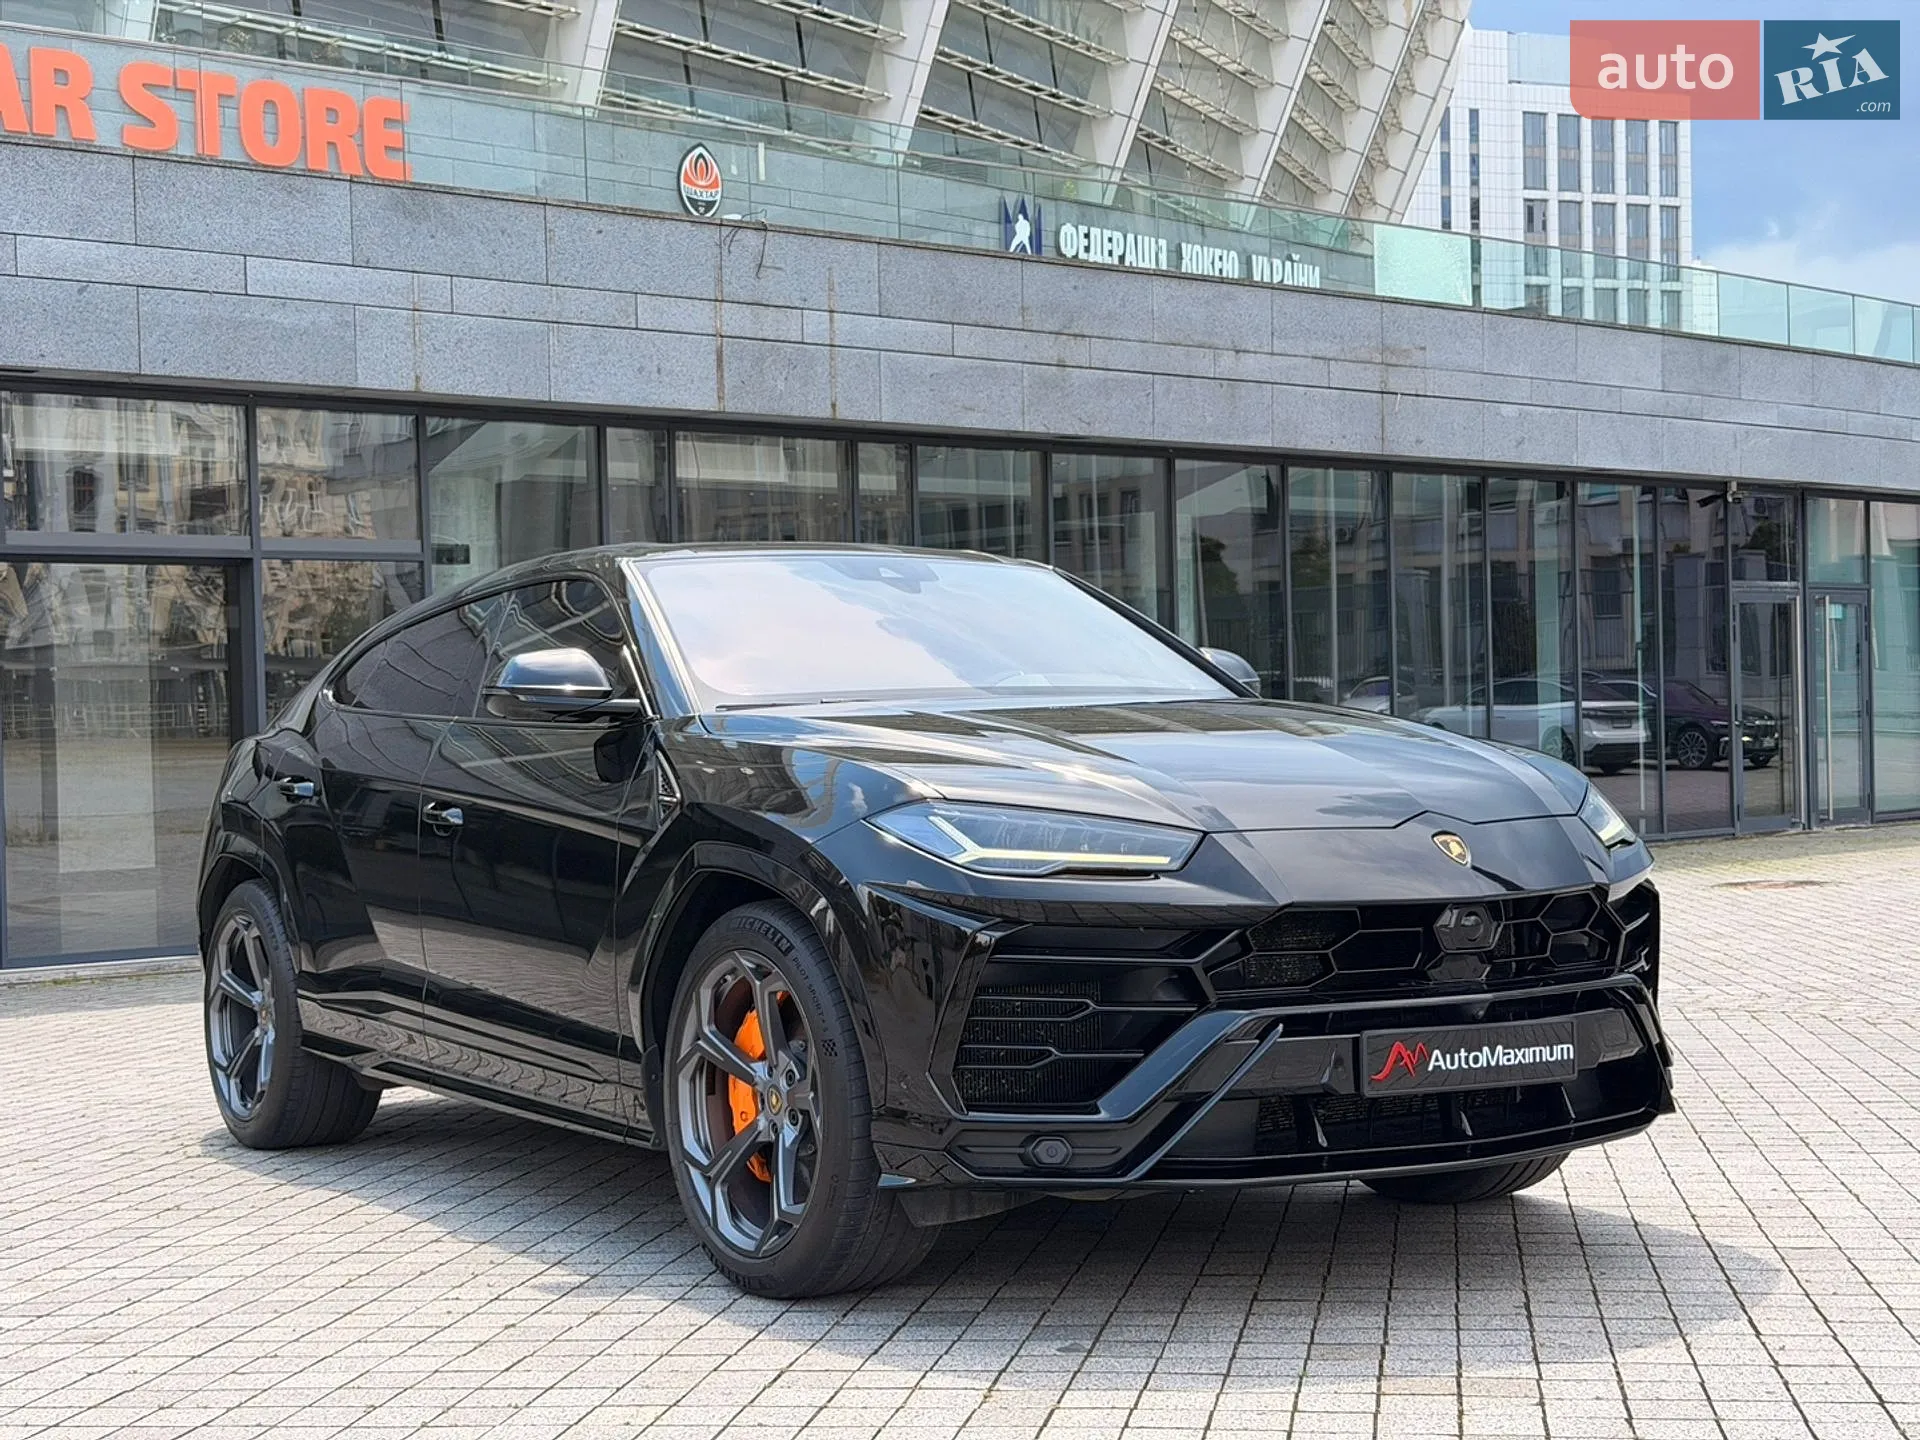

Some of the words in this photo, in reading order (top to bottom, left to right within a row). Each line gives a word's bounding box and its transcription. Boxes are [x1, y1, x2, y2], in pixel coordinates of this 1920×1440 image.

[118, 60, 412, 181] STORE
[1059, 223, 1167, 269] ФЕДЕРАЦІЯ
[1181, 242, 1239, 279] ХОКЕЮ
[1428, 1043, 1574, 1072] AutoMaximum
